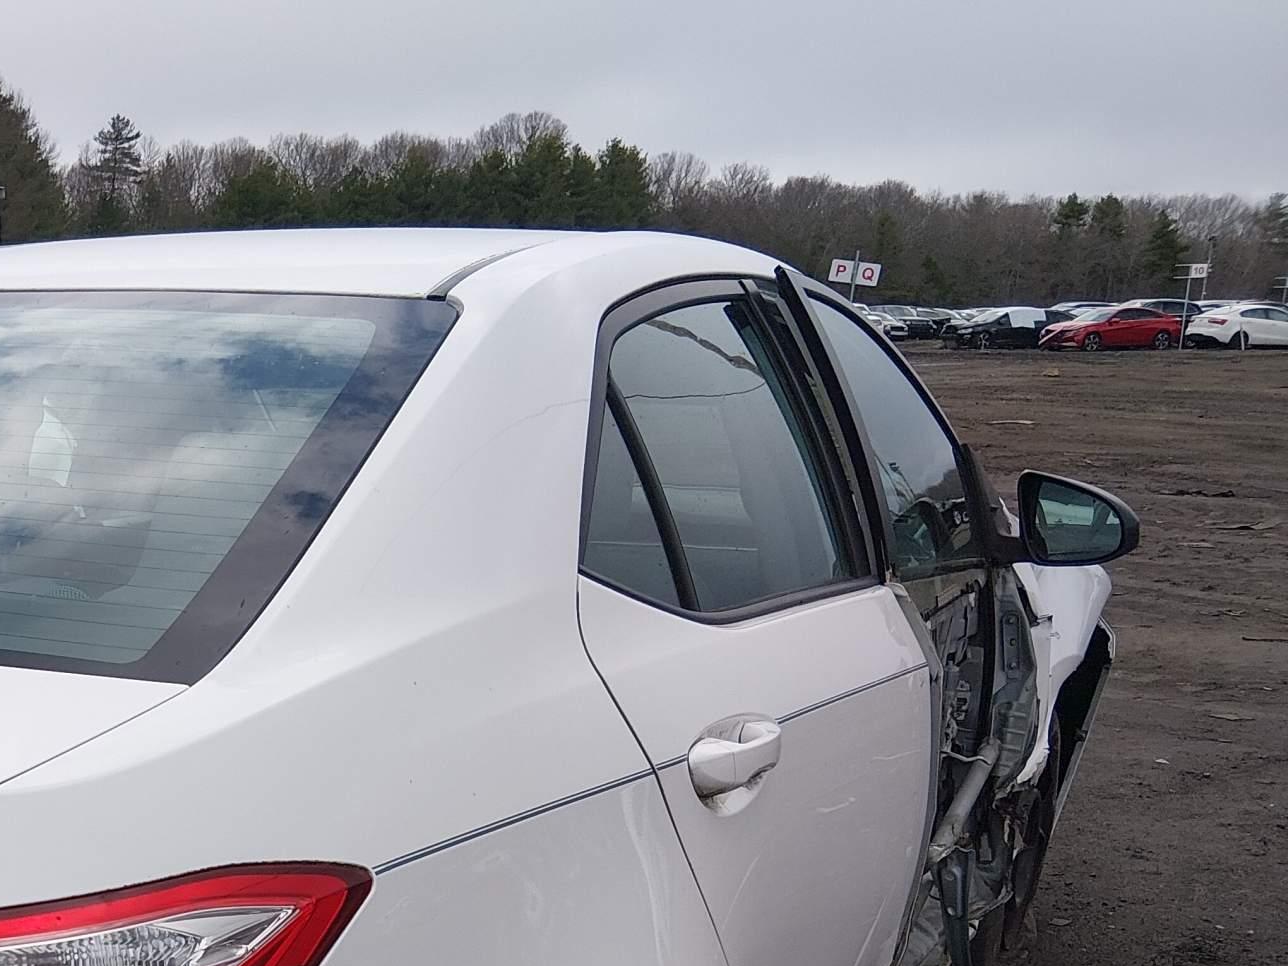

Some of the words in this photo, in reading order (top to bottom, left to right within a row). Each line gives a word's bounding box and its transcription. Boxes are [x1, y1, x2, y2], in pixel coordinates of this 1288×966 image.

[835, 264, 847, 277] P
[862, 267, 874, 282] Q
[1193, 266, 1205, 275] 10
